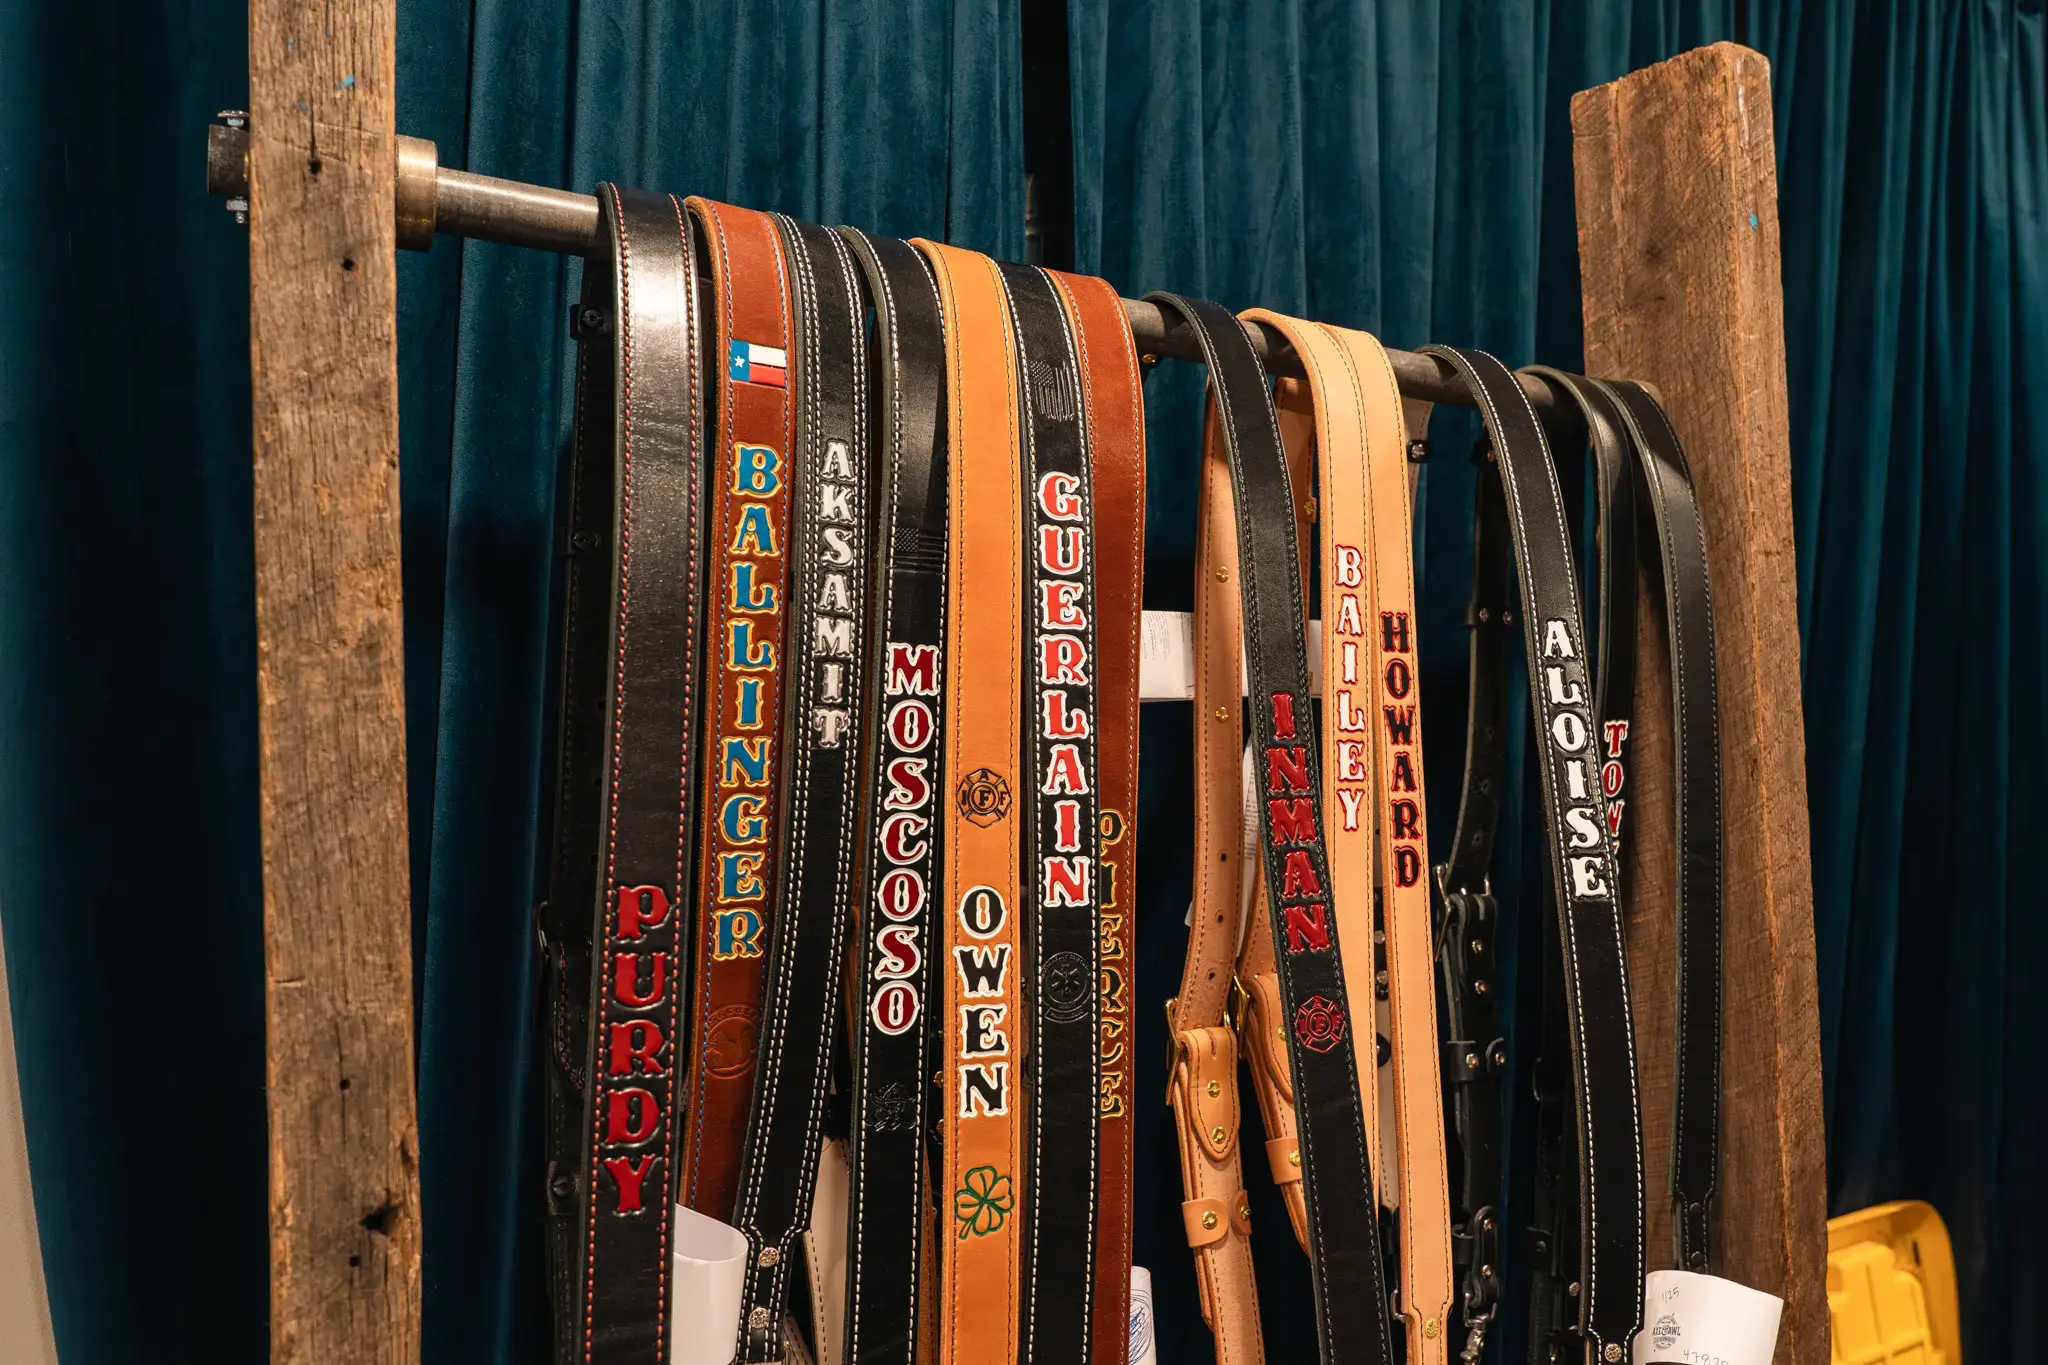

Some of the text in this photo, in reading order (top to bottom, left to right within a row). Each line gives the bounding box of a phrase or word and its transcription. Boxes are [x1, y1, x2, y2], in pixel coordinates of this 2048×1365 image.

[712, 442, 783, 961] BALLINGER
[813, 438, 854, 749] AKSAMIT
[1037, 470, 1090, 907] GUERLAIN
[1335, 544, 1366, 833] BAILEY
[870, 643, 940, 1036] MOSCOSO
[1266, 691, 1333, 954] INMAN
[1380, 611, 1422, 888] HOWARD
[1542, 618, 1609, 899] ALOISE
[602, 884, 675, 1216] PURDY
[953, 885, 1012, 1118] OWEN
